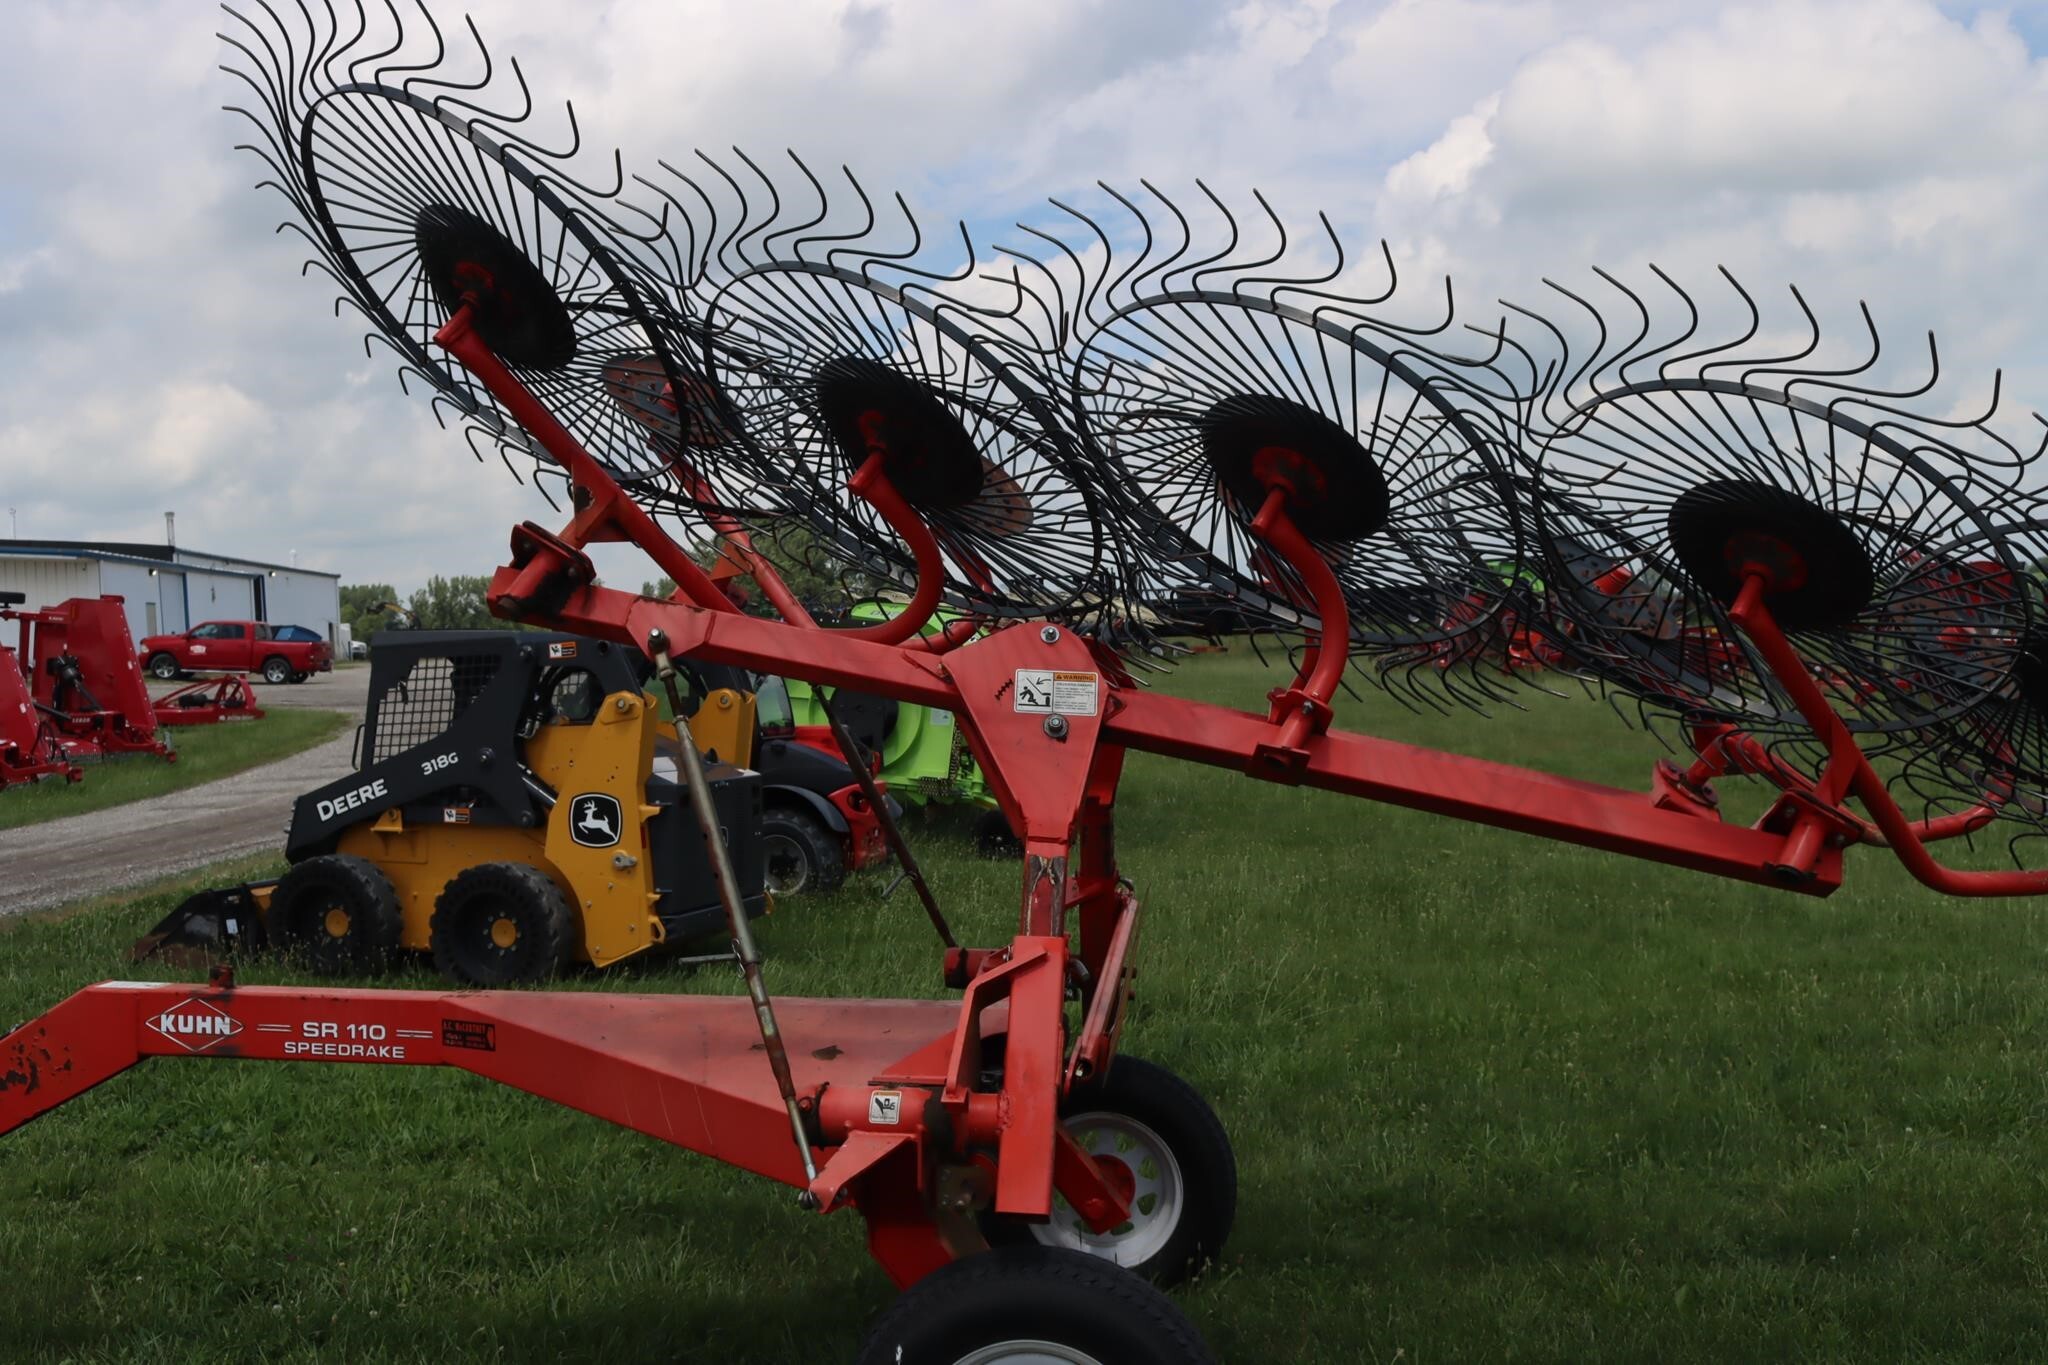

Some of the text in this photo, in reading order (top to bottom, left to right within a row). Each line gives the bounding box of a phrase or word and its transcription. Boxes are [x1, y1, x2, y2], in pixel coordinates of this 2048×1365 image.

[421, 752, 459, 775] 318G
[316, 778, 388, 822] DEERE
[160, 1014, 231, 1035] KUHN
[302, 1022, 386, 1041] SR 110
[284, 1041, 405, 1059] SPEEDRAKE
